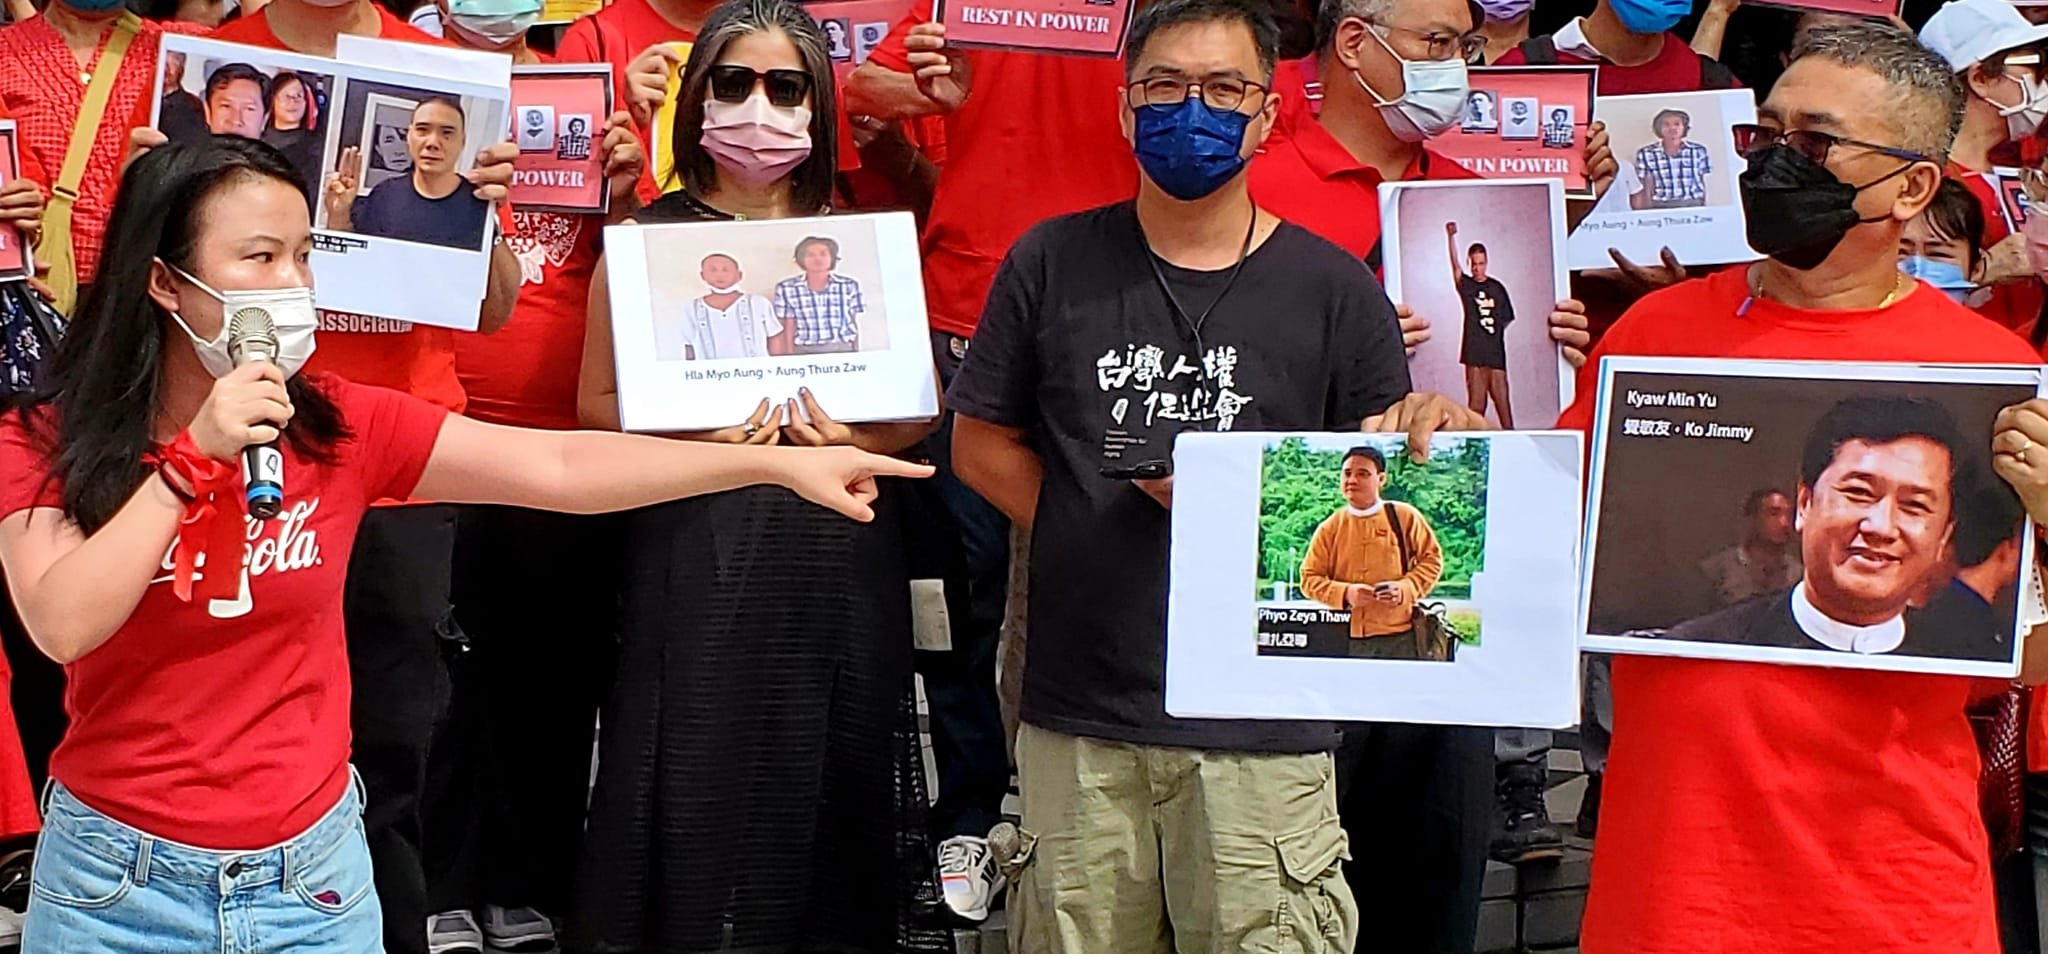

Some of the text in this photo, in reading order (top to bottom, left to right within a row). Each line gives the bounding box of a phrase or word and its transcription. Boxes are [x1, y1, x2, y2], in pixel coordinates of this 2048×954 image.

[962, 6, 1109, 33] REST IN POWER
[1477, 157, 1497, 173] IN
[1500, 157, 1568, 173] POWER
[511, 170, 585, 187] POWER
[315, 310, 413, 333] Associati
[685, 362, 867, 382] Hla Myo Aung Aung Thura Zaw
[1626, 390, 1717, 408] Kyaw Min Yu
[1684, 421, 1704, 437] Ko
[1705, 422, 1754, 442] Jimmy
[1259, 608, 1351, 625] Phyo Zeya Thaw
